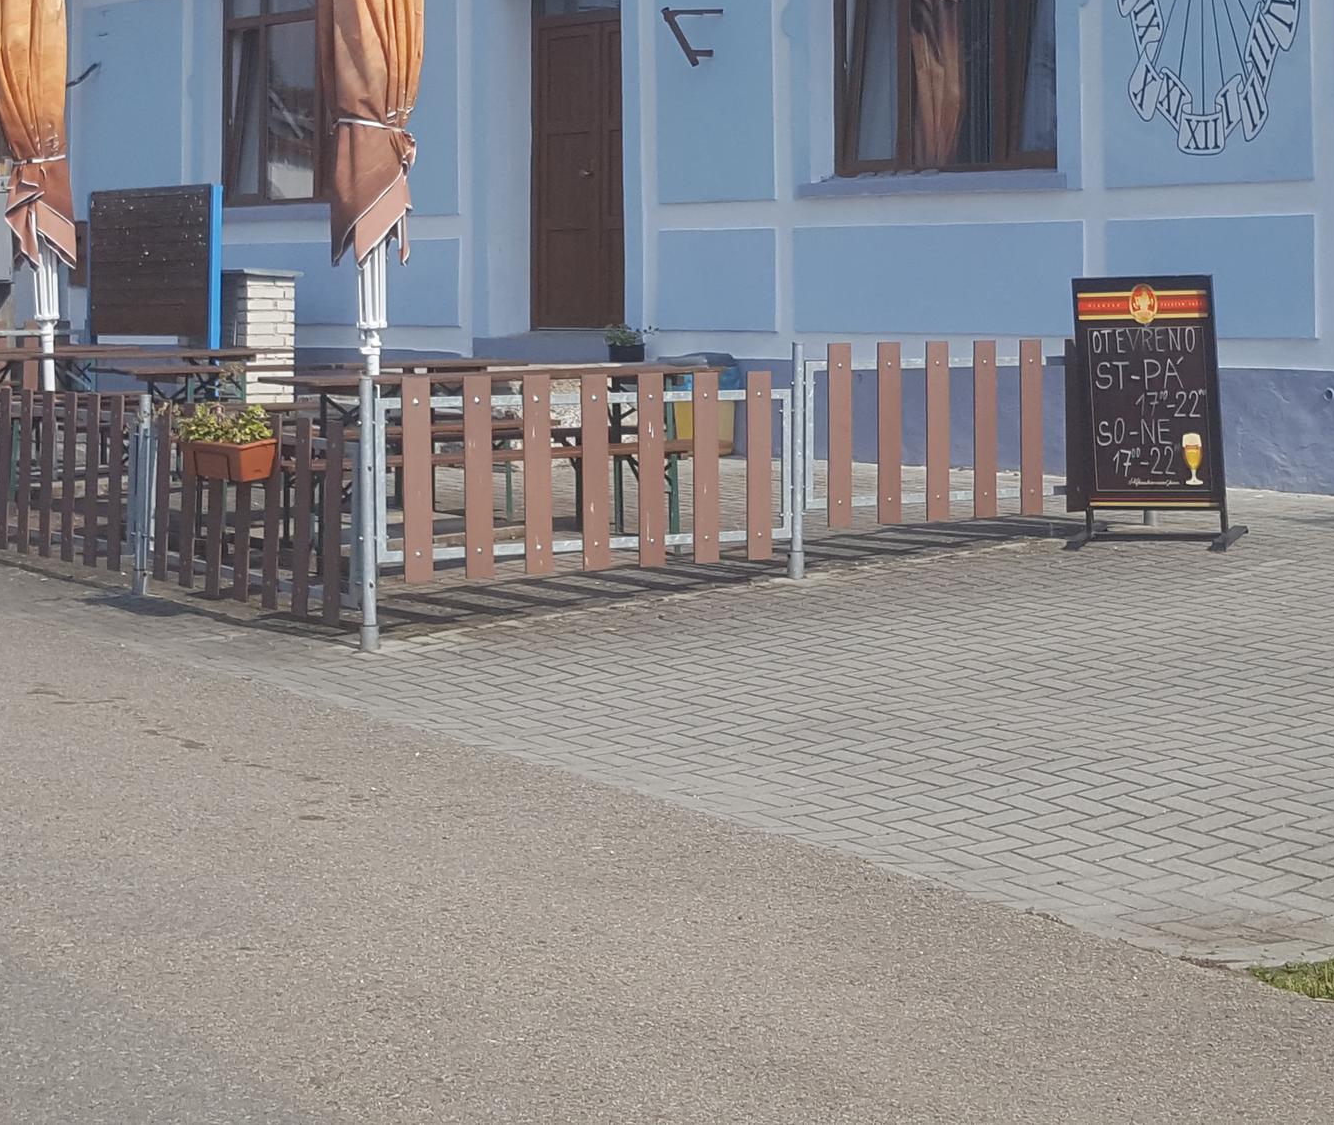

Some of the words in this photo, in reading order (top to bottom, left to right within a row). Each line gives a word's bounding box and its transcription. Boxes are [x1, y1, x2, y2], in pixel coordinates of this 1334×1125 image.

[1133, 64, 1158, 111] X
[1159, 72, 1186, 125] XI
[1184, 118, 1221, 151] XII
[1095, 356, 1185, 390] ST-PÁ
[1096, 417, 1173, 446] SO-NE
